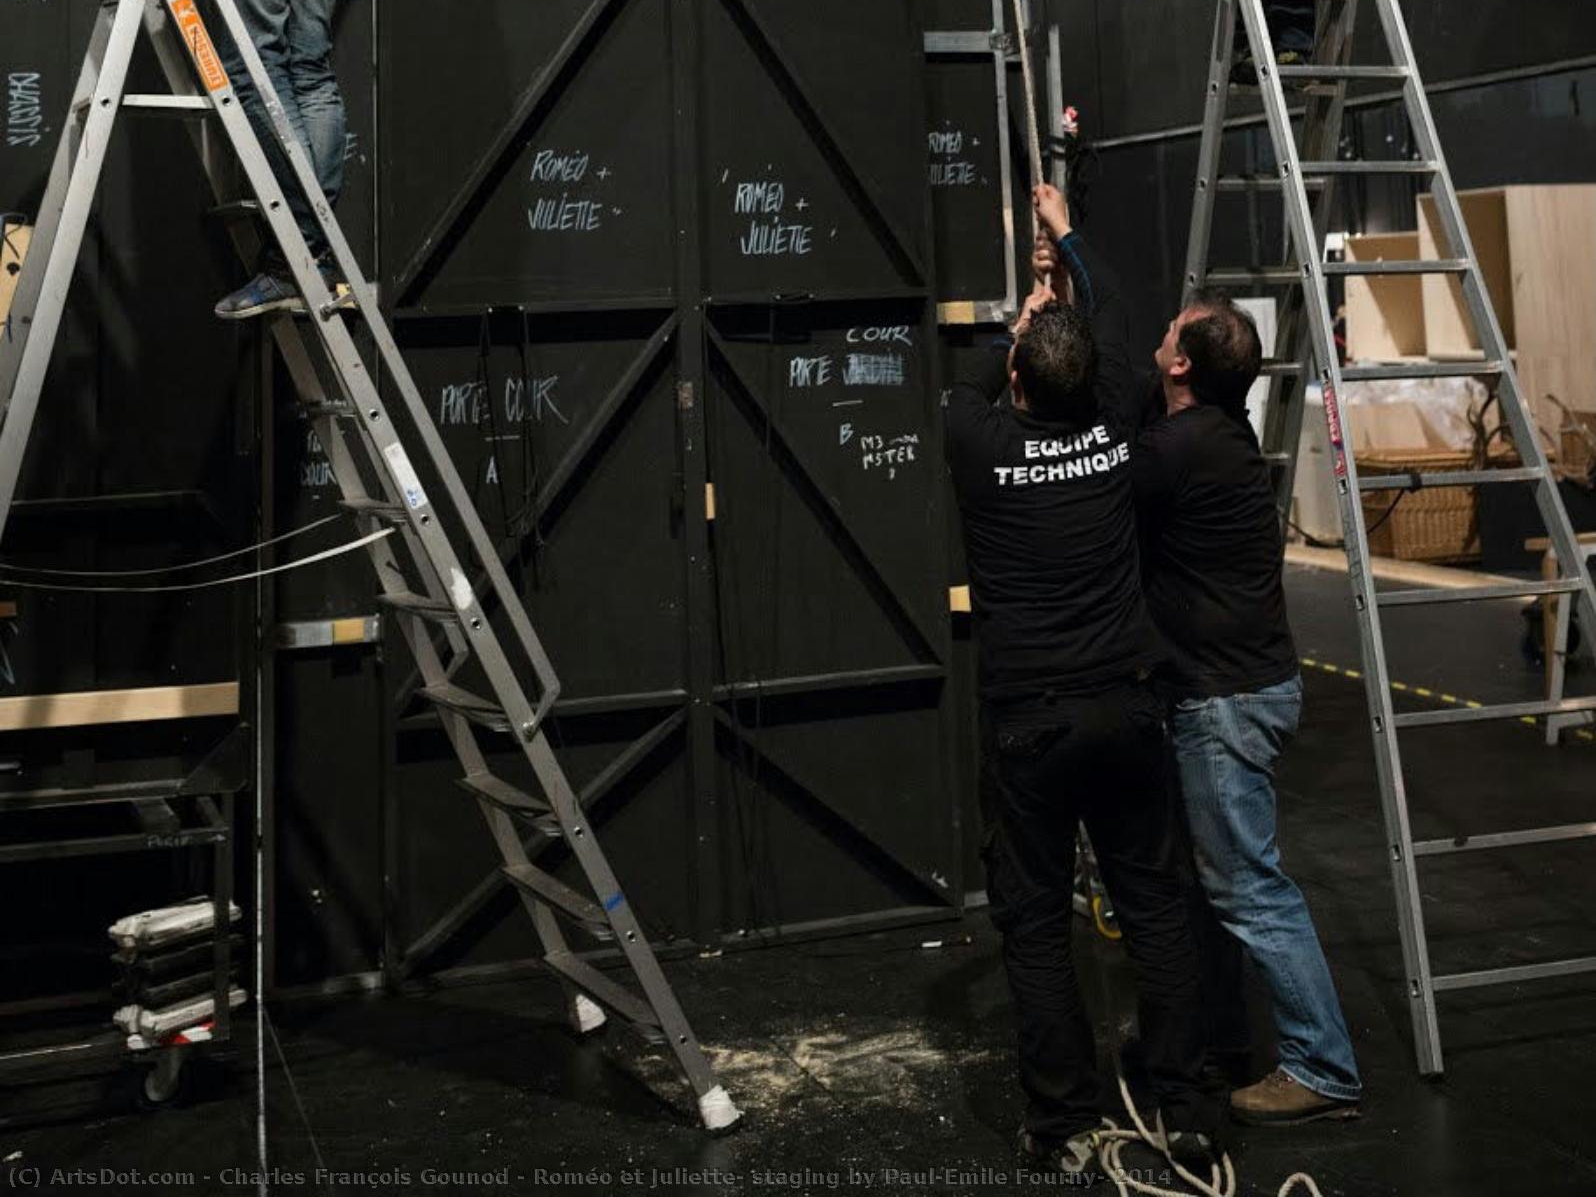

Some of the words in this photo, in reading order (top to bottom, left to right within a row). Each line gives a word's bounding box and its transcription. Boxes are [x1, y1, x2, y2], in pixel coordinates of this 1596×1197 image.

[845, 325, 913, 347] COUR
[1024, 424, 1110, 459] EQUIPE
[486, 455, 498, 484] A
[993, 441, 1130, 486] TECHNIQUE
